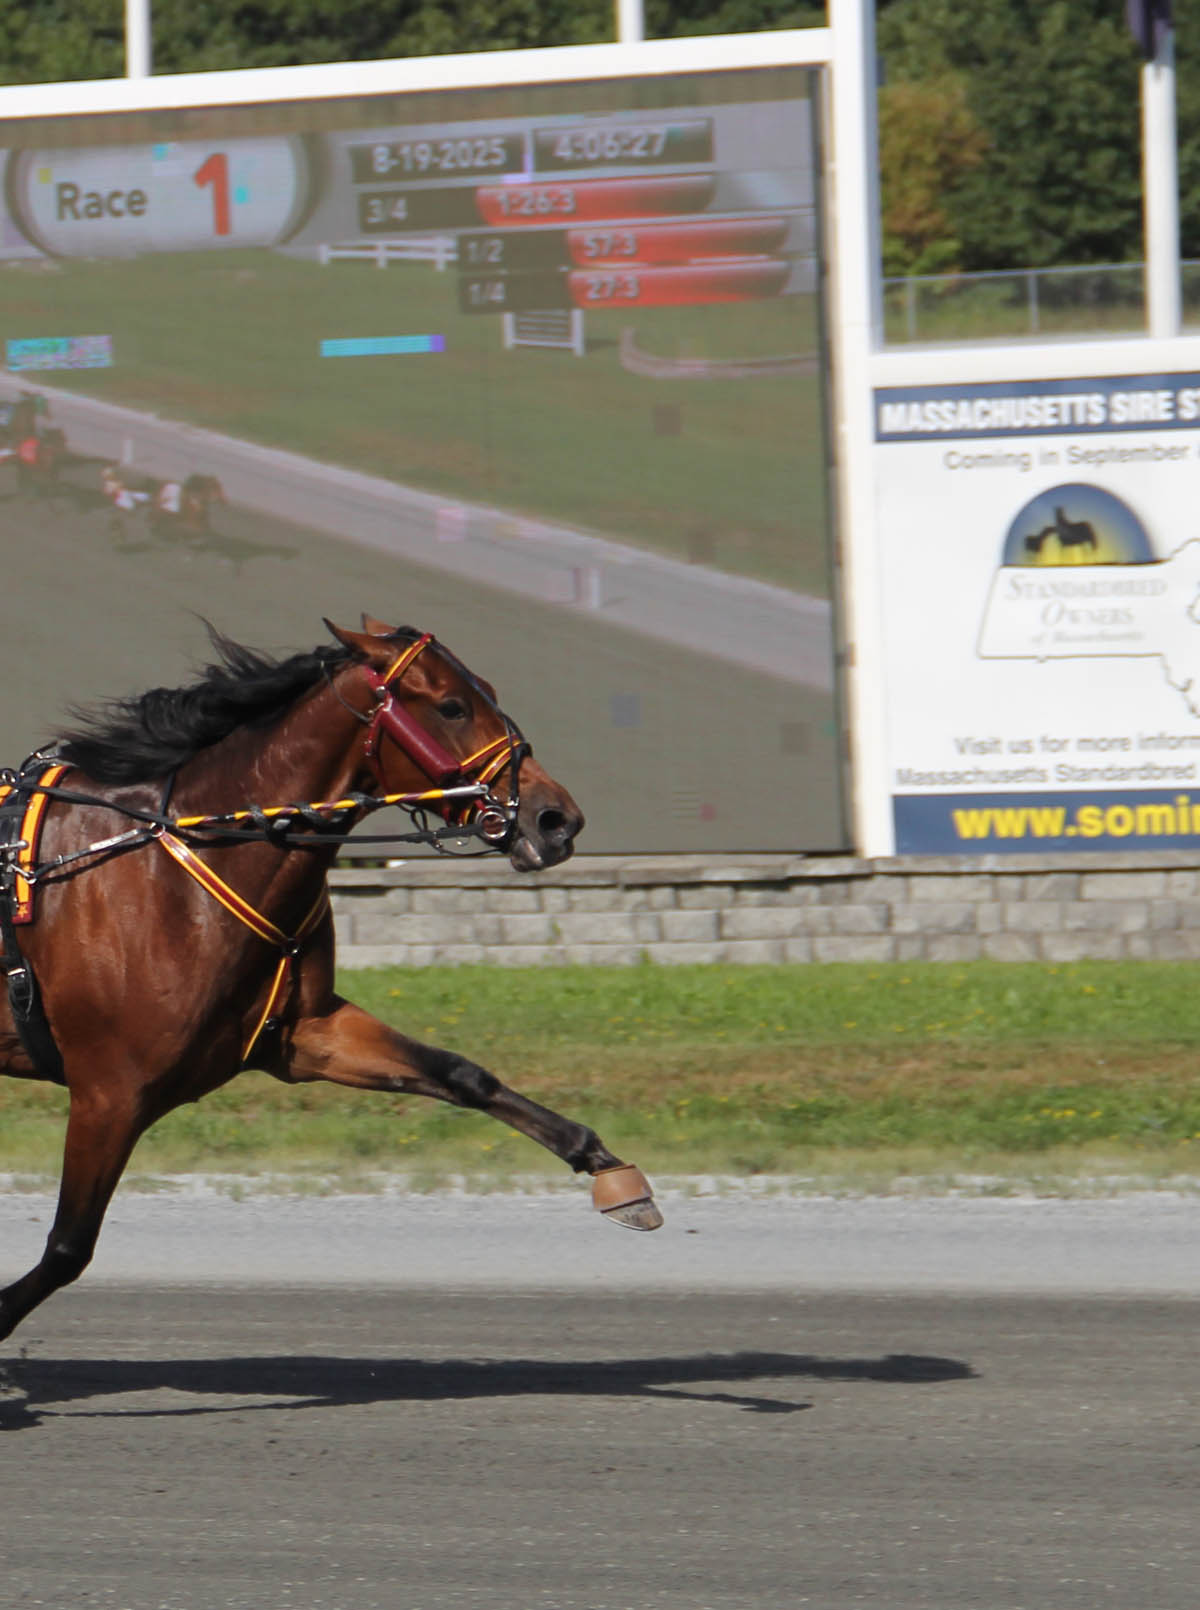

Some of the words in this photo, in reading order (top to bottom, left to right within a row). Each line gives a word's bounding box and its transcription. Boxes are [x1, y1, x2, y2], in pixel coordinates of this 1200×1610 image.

[55, 181, 148, 223] Race
[192, 152, 232, 236] 1
[878, 393, 1106, 434] MASSACHUSETTS
[1109, 389, 1175, 423] SIRE
[943, 450, 1031, 472] Coming
[1039, 447, 1060, 465] in
[1066, 443, 1190, 467] September
[953, 736, 1002, 756] Visit
[1008, 738, 1033, 754] us
[1040, 734, 1069, 753] for
[1076, 736, 1131, 752] more
[895, 766, 1048, 786] Massachusetts
[1055, 761, 1196, 783] Standardbred
